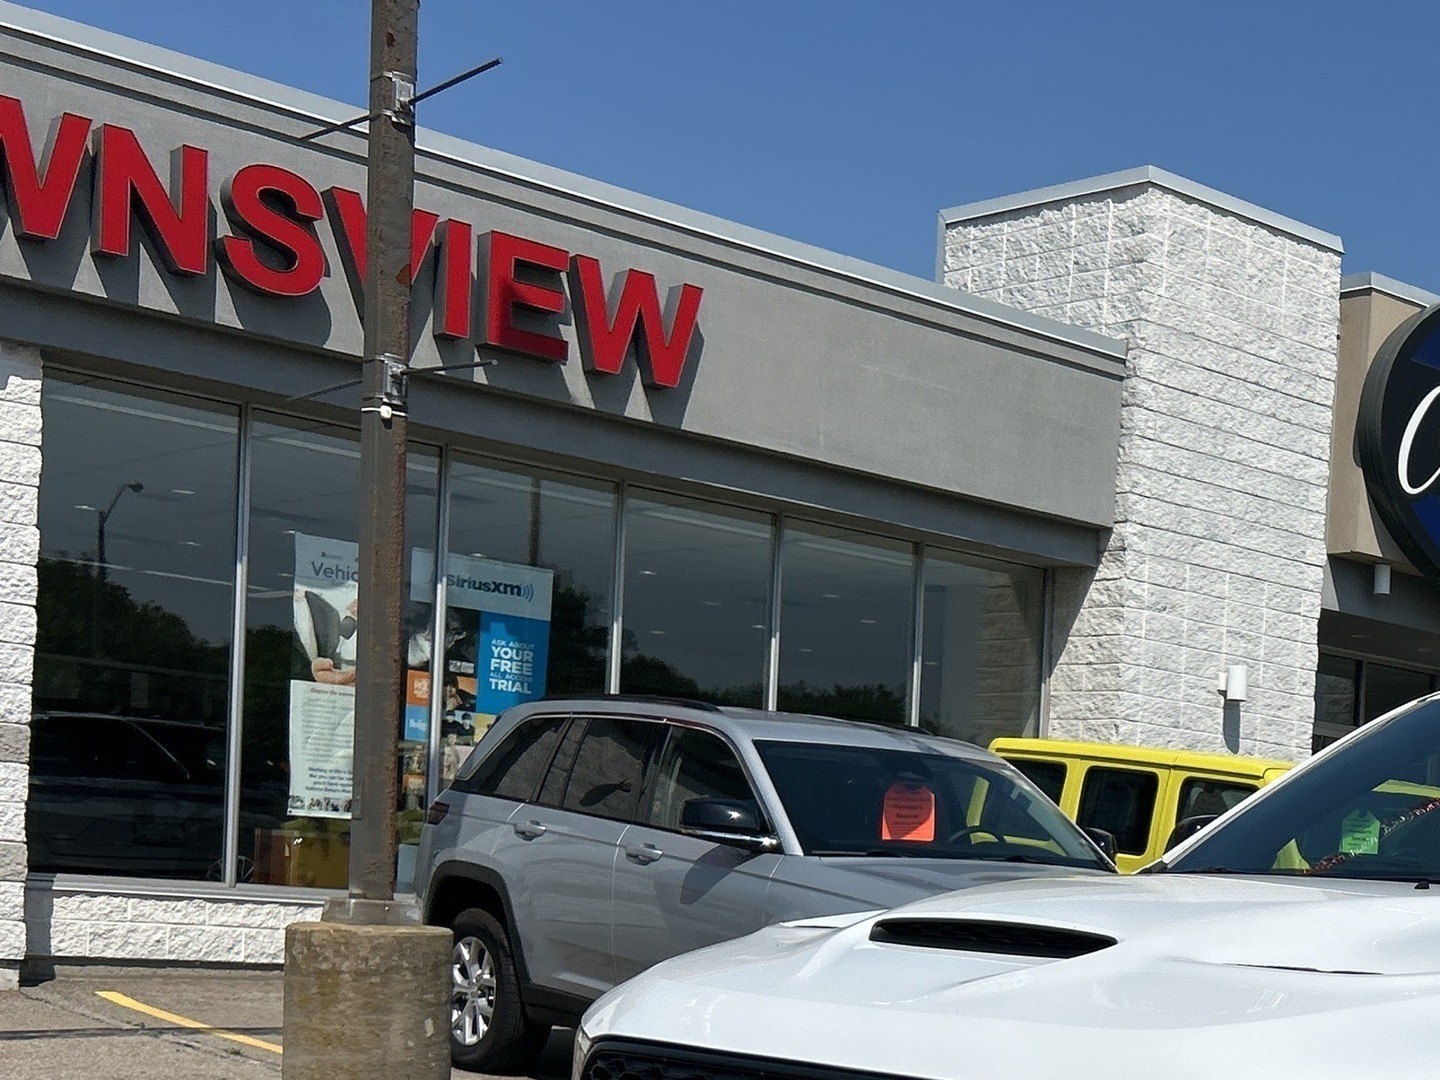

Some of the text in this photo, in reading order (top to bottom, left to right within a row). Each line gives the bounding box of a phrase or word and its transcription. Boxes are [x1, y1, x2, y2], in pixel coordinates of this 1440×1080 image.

[508, 640, 535, 650] ABOUT
[491, 646, 534, 662] YOUR
[490, 658, 533, 675] FREE
[489, 678, 532, 694] TRIAL
